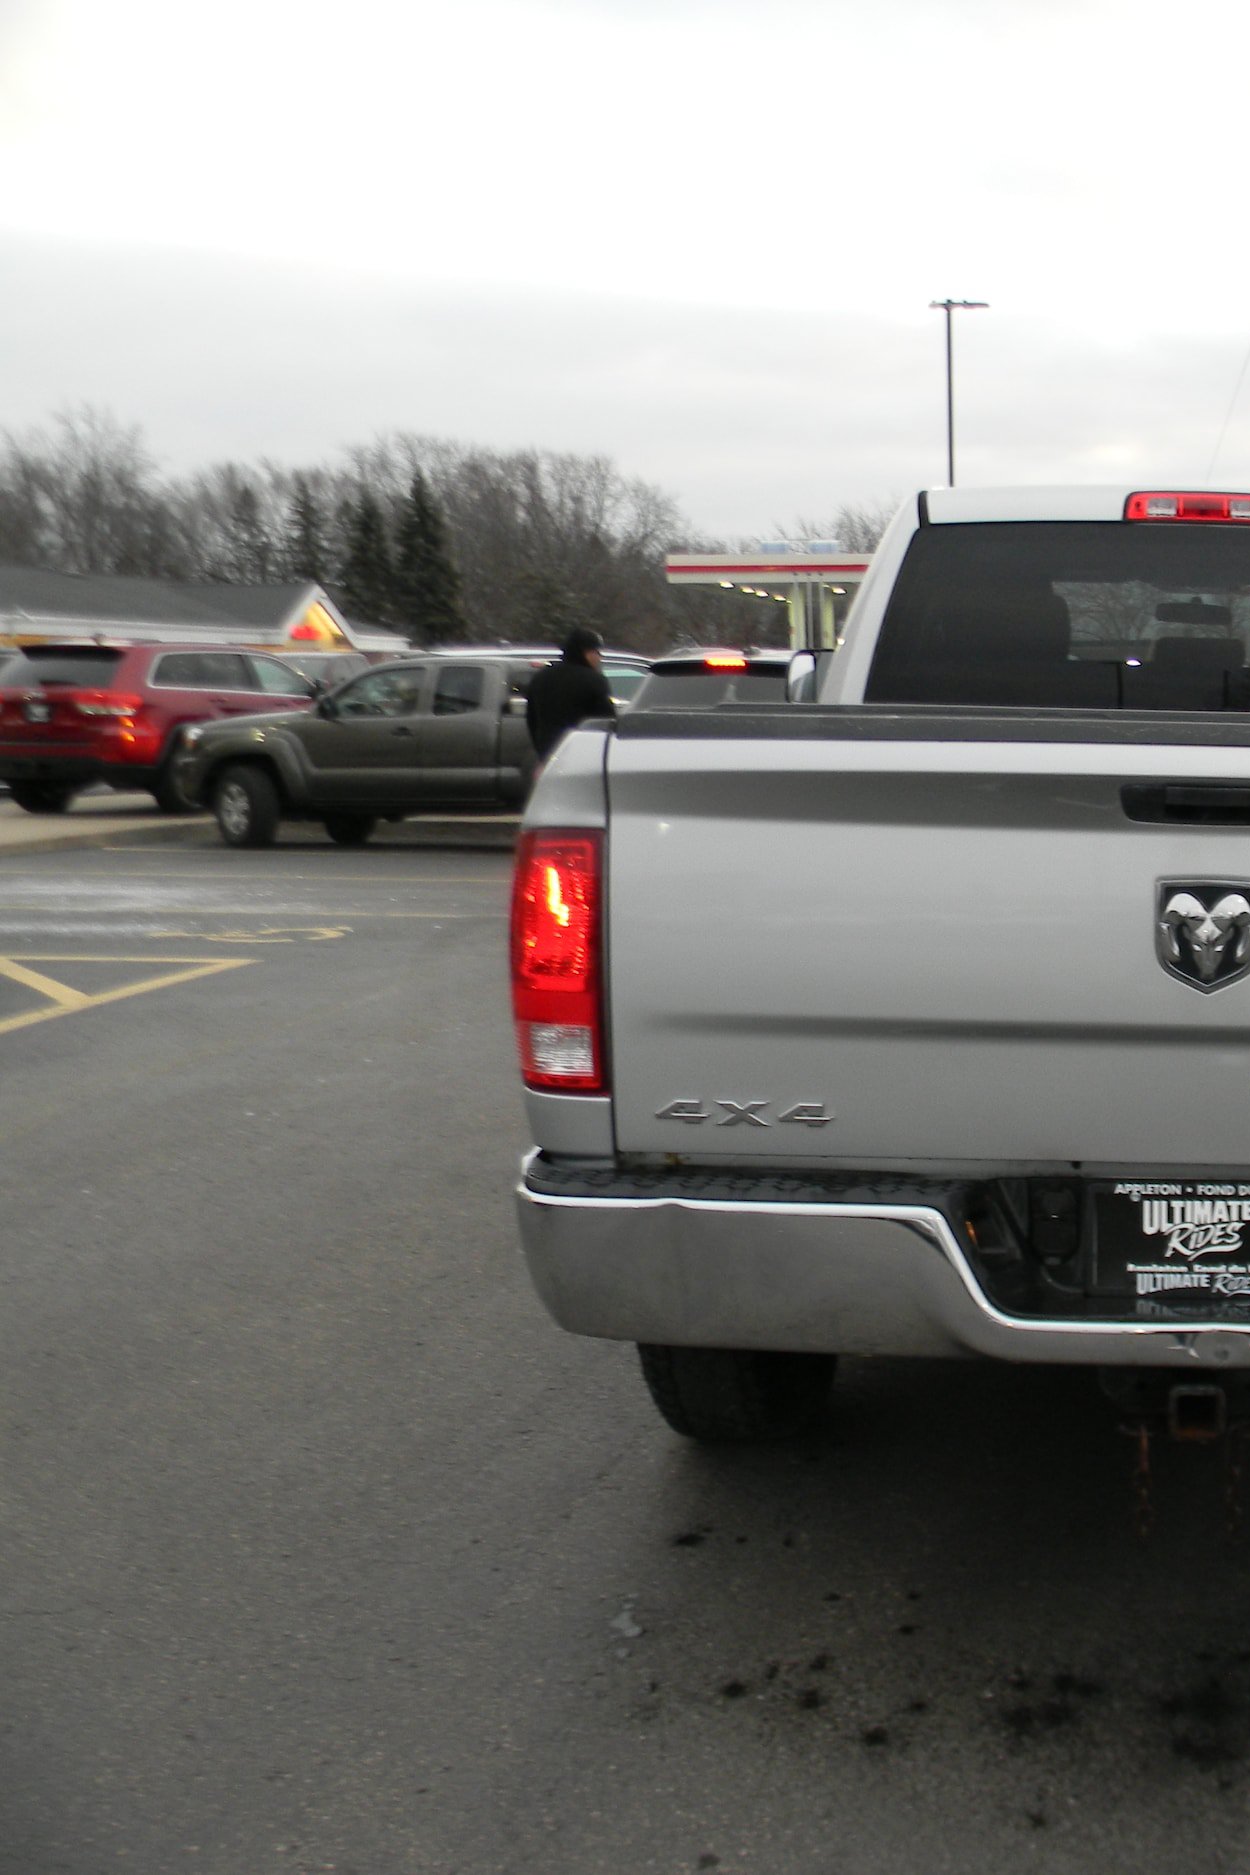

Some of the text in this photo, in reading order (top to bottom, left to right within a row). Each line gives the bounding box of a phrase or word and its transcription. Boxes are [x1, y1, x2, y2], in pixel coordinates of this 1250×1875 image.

[1114, 1183, 1183, 1195] APPLETON
[1197, 1184, 1236, 1196] FOND
[1136, 1273, 1210, 1295] ULTIMATE
